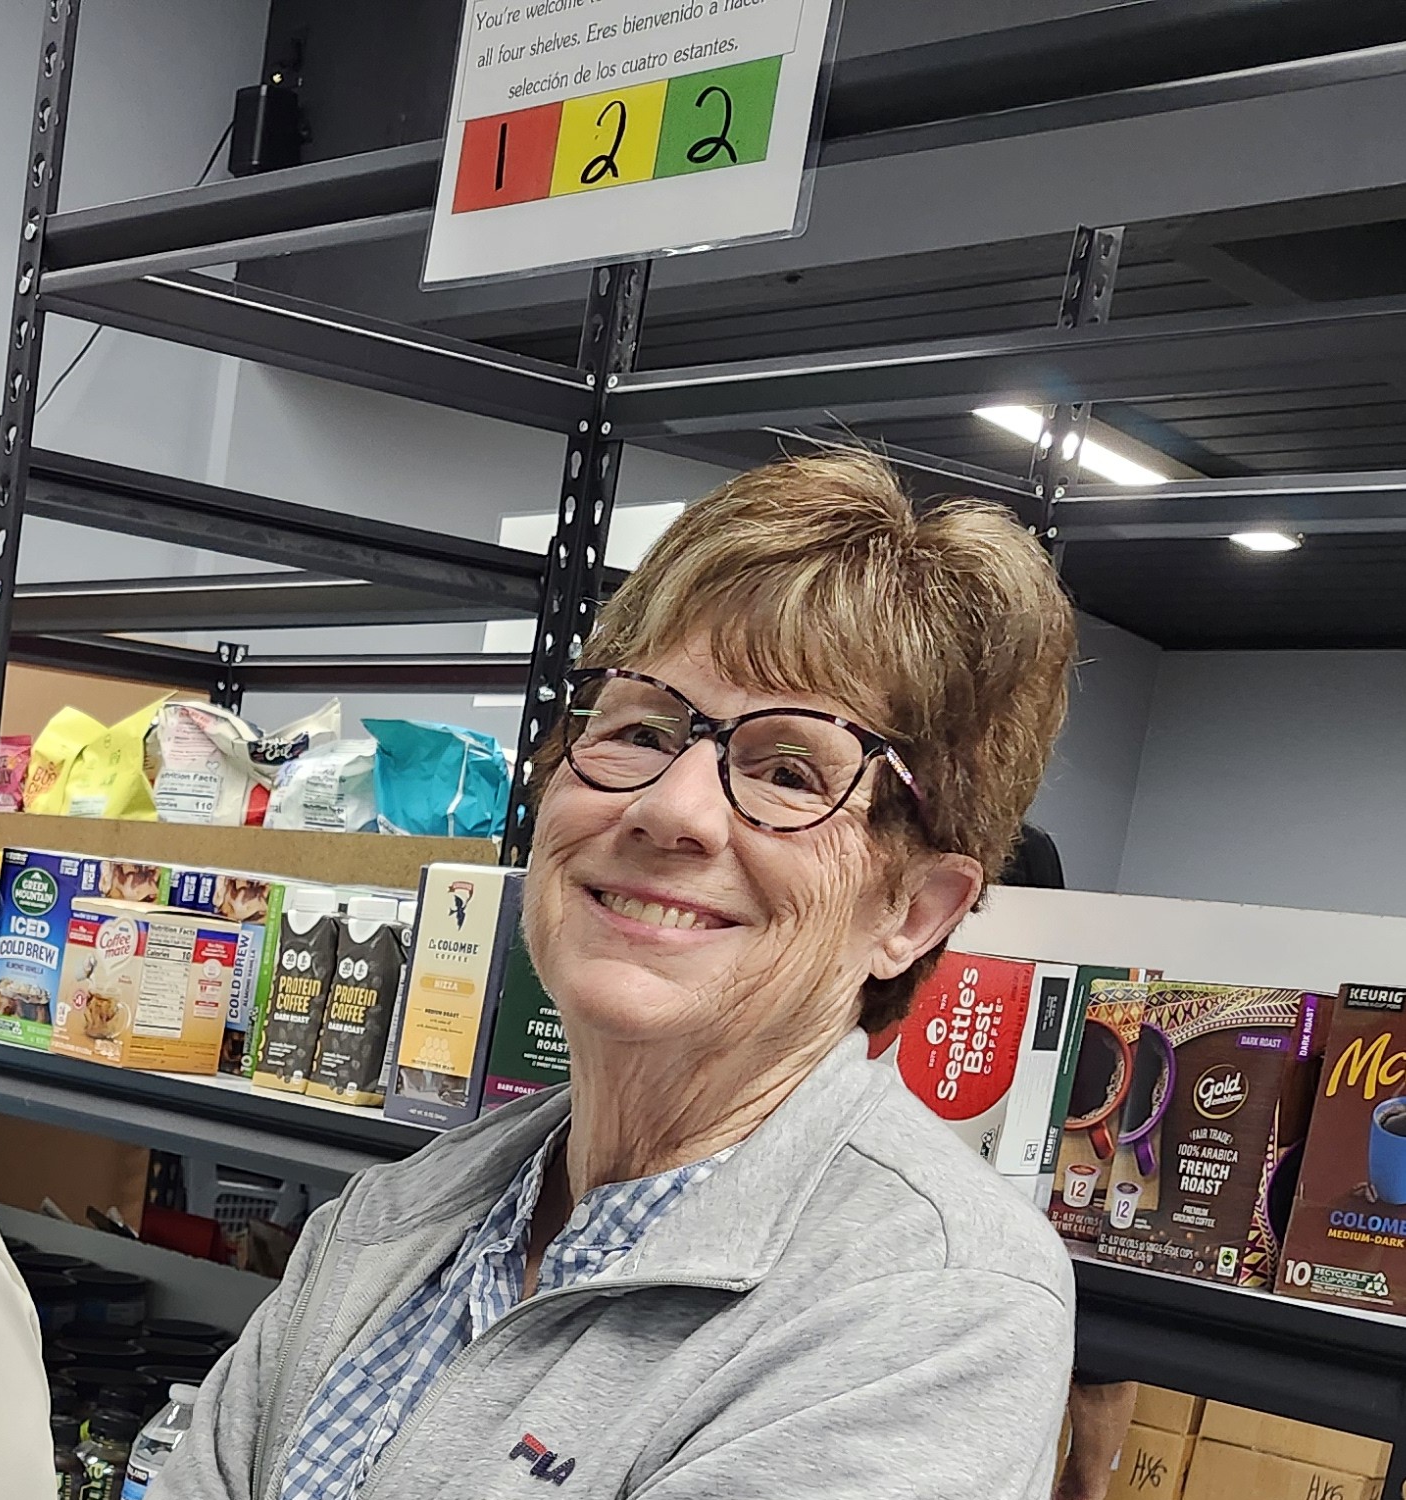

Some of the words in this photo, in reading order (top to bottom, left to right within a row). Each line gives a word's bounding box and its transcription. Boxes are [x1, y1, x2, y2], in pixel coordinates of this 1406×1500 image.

[476, 8, 520, 31] You're
[477, 48, 493, 68] all
[498, 43, 525, 64] four
[530, 33, 581, 56] shelves.
[587, 23, 618, 44] Eres
[622, 2, 704, 35] bienvenido
[709, 2, 718, 15] a
[508, 69, 569, 99] selección
[574, 62, 592, 85] de
[597, 60, 617, 81] los
[621, 51, 668, 76] cuatro
[673, 36, 739, 64] estantes.
[494, 122, 508, 192] 1
[580, 100, 627, 184] 2
[686, 86, 738, 165] 2
[161, 772, 191, 780] utrition
[195, 801, 213, 811] 110
[22, 880, 49, 892] GREEN
[15, 888, 54, 904] MOUNTAIN
[10, 915, 51, 939] ICED
[179, 927, 196, 936] Facts
[99, 931, 131, 949] Coffee
[437, 939, 479, 955] COLOMBE
[0, 939, 25, 956] COLD
[25, 941, 56, 965] BREW
[104, 944, 131, 960] mate
[146, 949, 170, 959] Calories
[182, 951, 192, 961] 10
[234, 934, 251, 977] BREW
[435, 953, 469, 963] COFFEE
[278, 975, 322, 997] PROTEIN
[333, 984, 378, 1007] PROTEIN
[228, 979, 242, 1019] COLD
[276, 993, 312, 1013] COFFEE
[1349, 988, 1404, 1004] KEURIG
[274, 1012, 290, 1021] DARK
[290, 1013, 311, 1024] ROAST
[330, 1002, 367, 1023] COFFEE
[1303, 1007, 1315, 1034] ROAST
[327, 1021, 343, 1031] DARK
[343, 1024, 366, 1035] ROAST
[527, 1020, 565, 1039] FREN
[936, 966, 979, 1101] Seattle's
[962, 1001, 994, 1074] Best
[536, 1039, 569, 1053] ROAST
[1240, 1035, 1258, 1047] DARK
[1258, 1037, 1282, 1048] ROAST
[1298, 1034, 1310, 1057] DARK
[497, 1082, 514, 1092] DARK
[1198, 1072, 1242, 1109] Gold
[1211, 1093, 1245, 1106] emblem
[1177, 1143, 1201, 1158] 100%
[1200, 1147, 1239, 1163] ARABICA
[1179, 1159, 1231, 1180] FRENCH
[1070, 1180, 1087, 1198] 12
[1180, 1177, 1223, 1196] ROAST
[1115, 1200, 1130, 1219] 12
[1172, 1212, 1196, 1225] GROUND
[1195, 1215, 1216, 1228] COFFEE
[1327, 1228, 1406, 1248] MEDIUM-DARK
[1285, 1259, 1312, 1286] 10
[1314, 1267, 1368, 1283] RECYCLABLE
[509, 1432, 575, 1487] FILA
